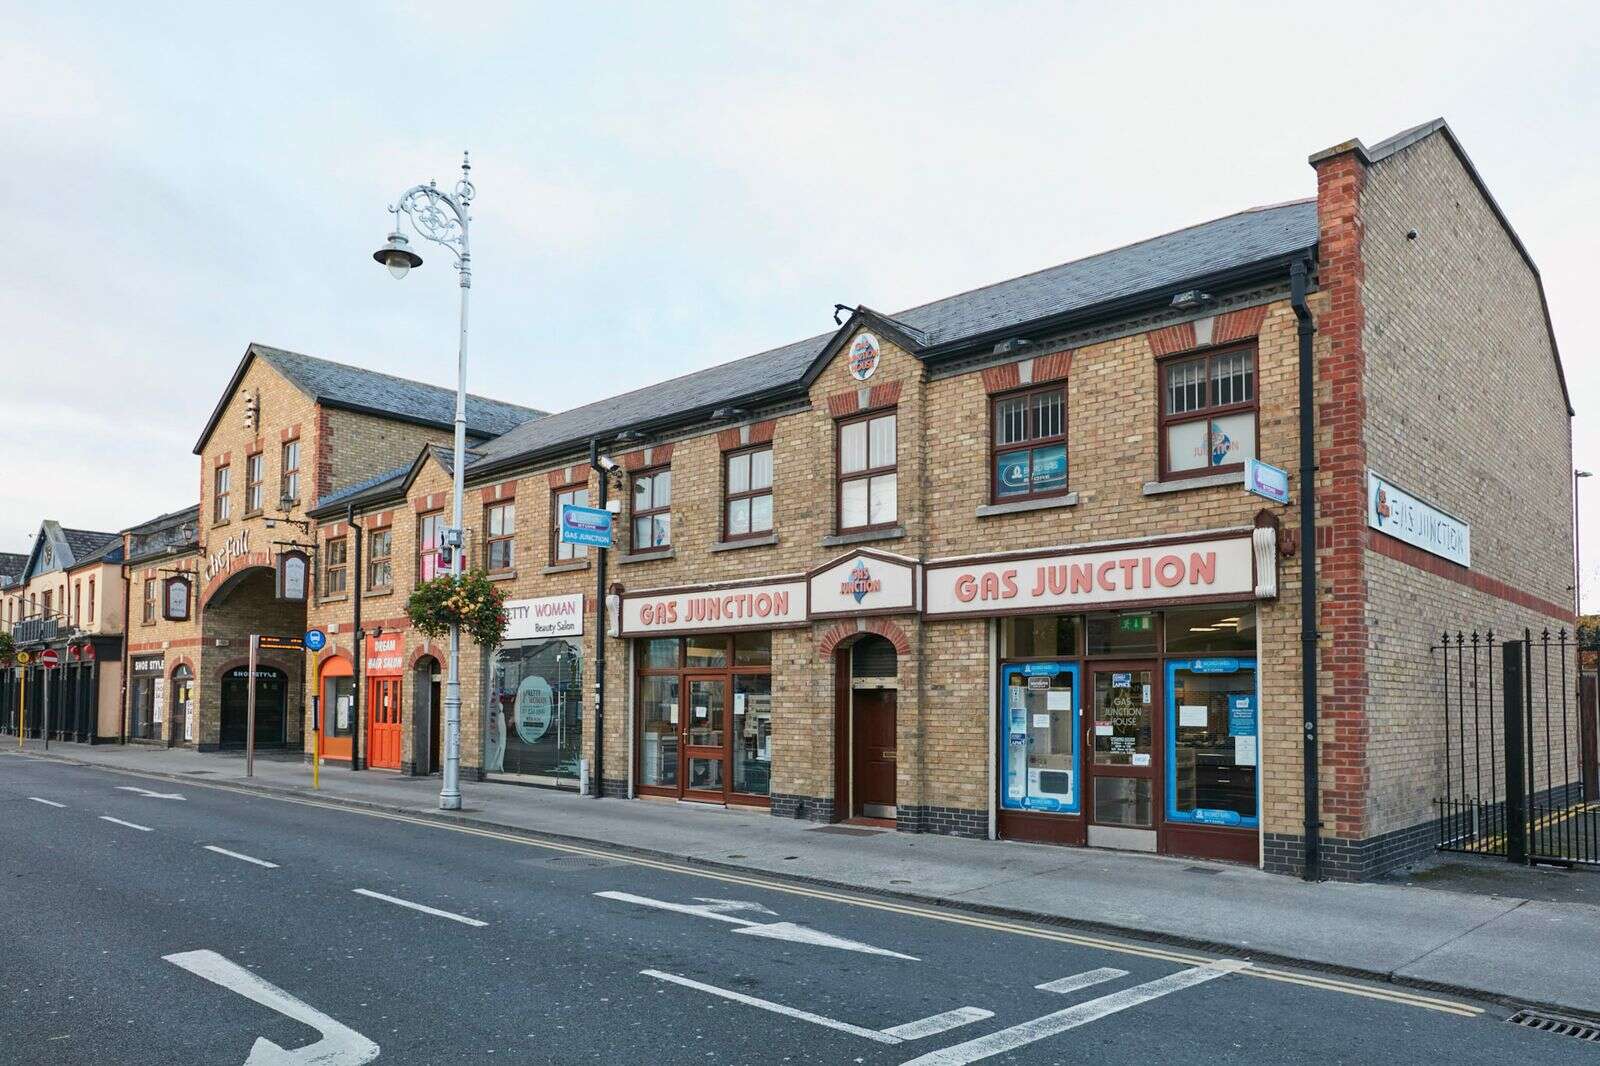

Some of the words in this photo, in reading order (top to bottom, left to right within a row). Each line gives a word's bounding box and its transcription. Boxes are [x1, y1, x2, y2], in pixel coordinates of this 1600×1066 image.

[579, 533, 609, 543] JUNCTION
[852, 567, 871, 580] GAS
[954, 569, 1018, 602] GAS
[1031, 551, 1216, 597] JUNCTION
[840, 579, 881, 595] JUNCTION
[507, 606, 530, 619] ETTY
[535, 601, 576, 618] WOMAN
[639, 600, 678, 626] GAS
[685, 591, 789, 622] JUNCTION
[535, 623, 556, 634] Beauty
[557, 620, 575, 631] Salon
[135, 661, 148, 671] SHOE
[149, 660, 164, 670] STYLE
[383, 656, 403, 668] SALON
[1113, 697, 1132, 706] GAS
[1104, 707, 1142, 717] JUNCTION
[1111, 718, 1137, 726] HOUSE
